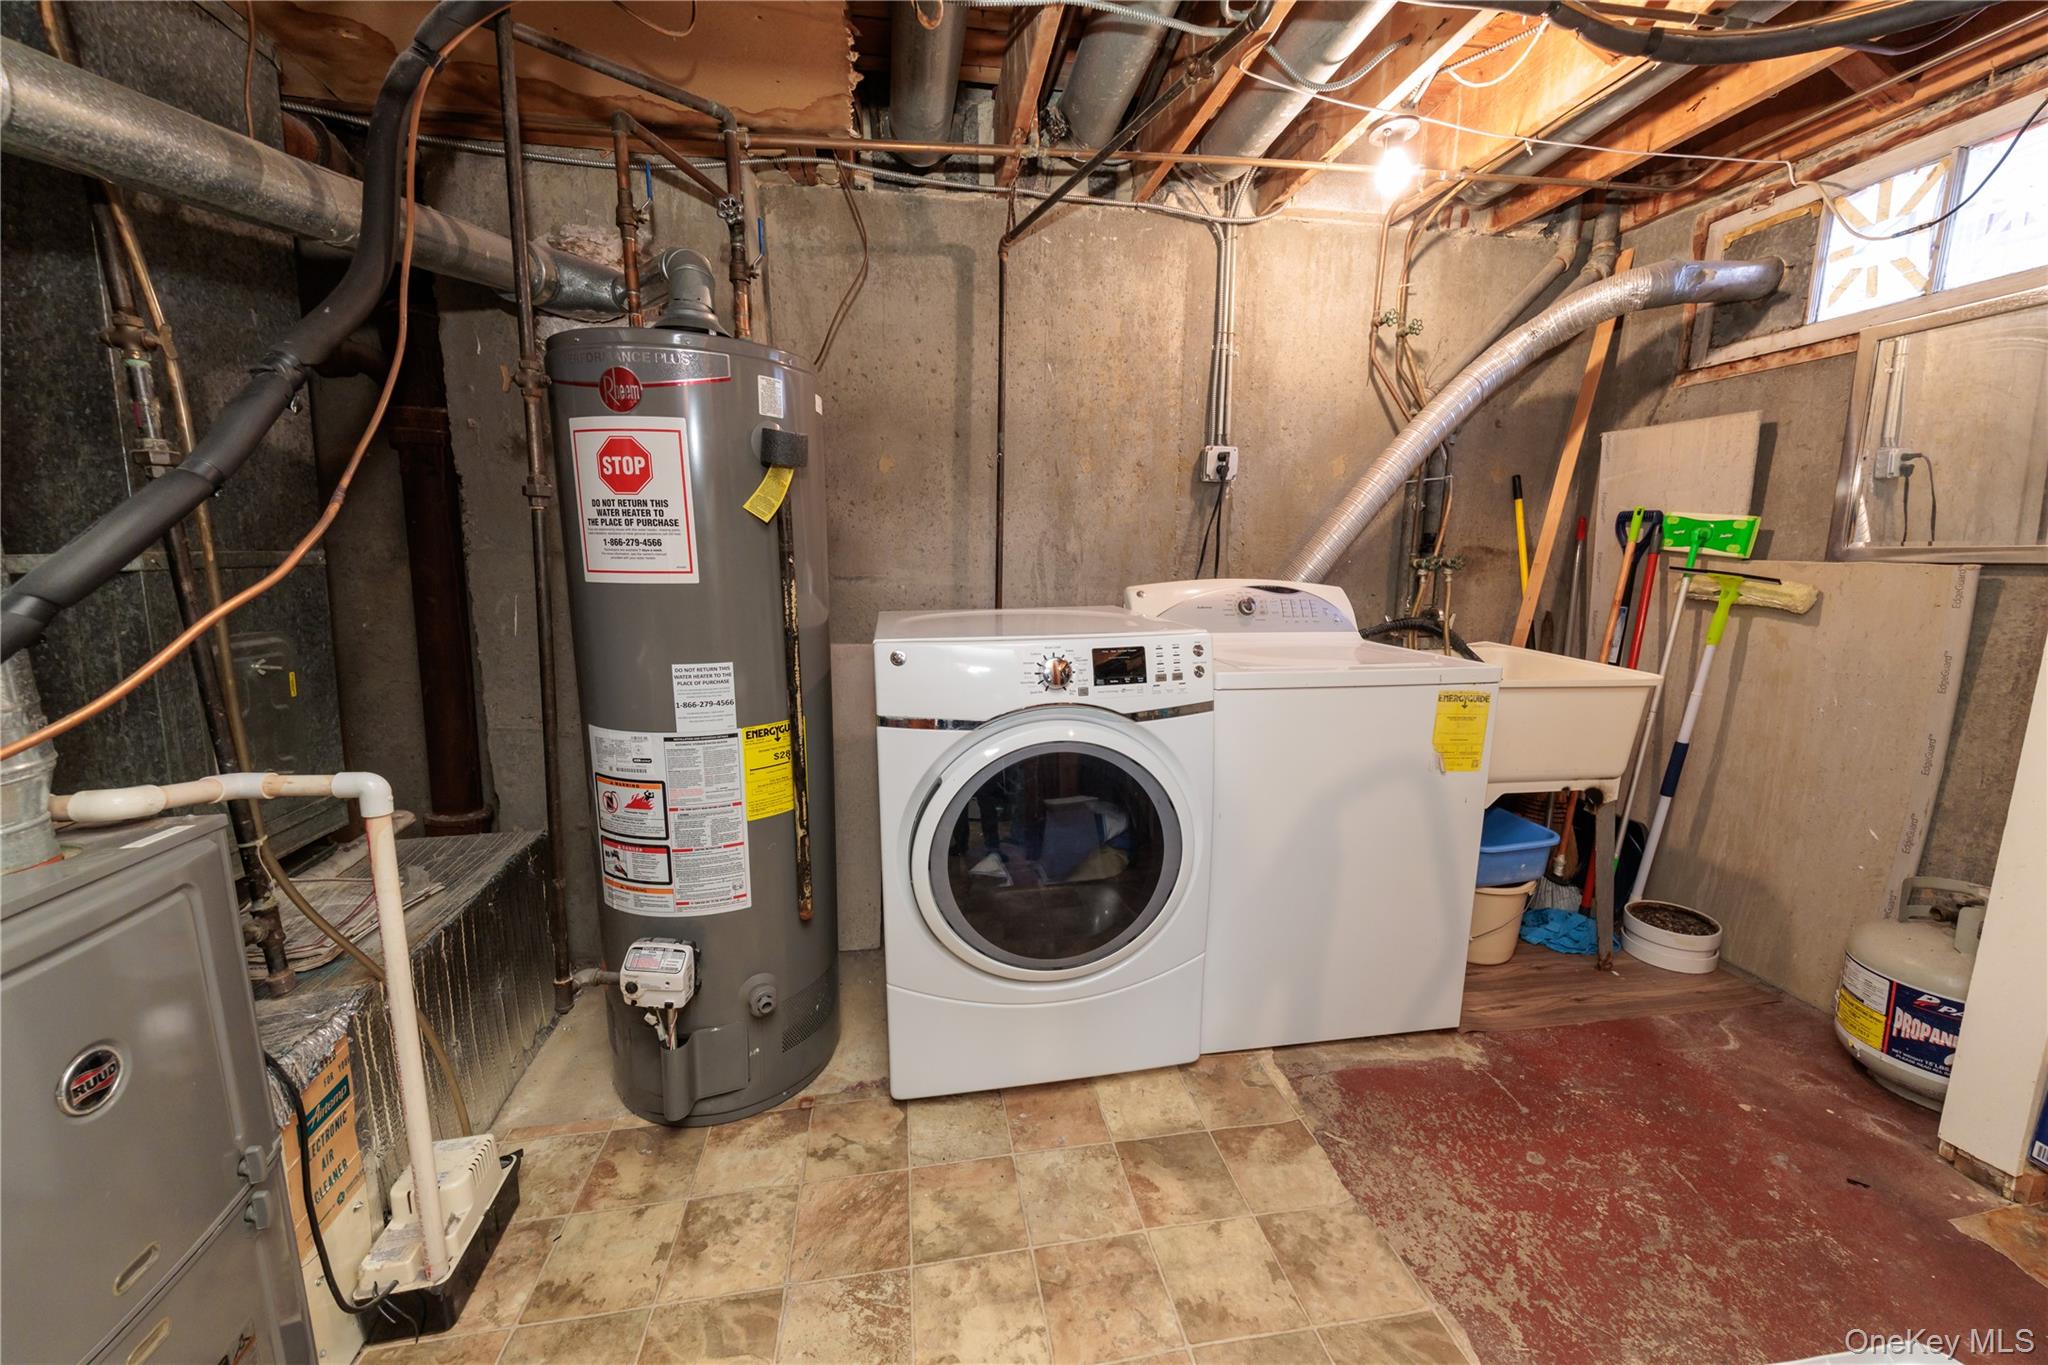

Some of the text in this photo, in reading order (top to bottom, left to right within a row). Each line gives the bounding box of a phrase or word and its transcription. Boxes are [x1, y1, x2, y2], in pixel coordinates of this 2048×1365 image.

[602, 367, 640, 406] Rheem
[602, 455, 646, 476] STOP
[592, 499, 669, 508] DO NOT RETURN THIS
[596, 508, 665, 518] WATER HEATER TO
[587, 518, 680, 528] THE PLACE OF PURCHASE
[603, 538, 662, 547] 1-866-279-4566
[675, 698, 735, 709] 1-866-279-4566
[746, 723, 791, 740] ENERGYGU
[72, 1062, 117, 1099] RUUD
[321, 1148, 335, 1173] AIR
[314, 1158, 348, 1205] CLEANER
